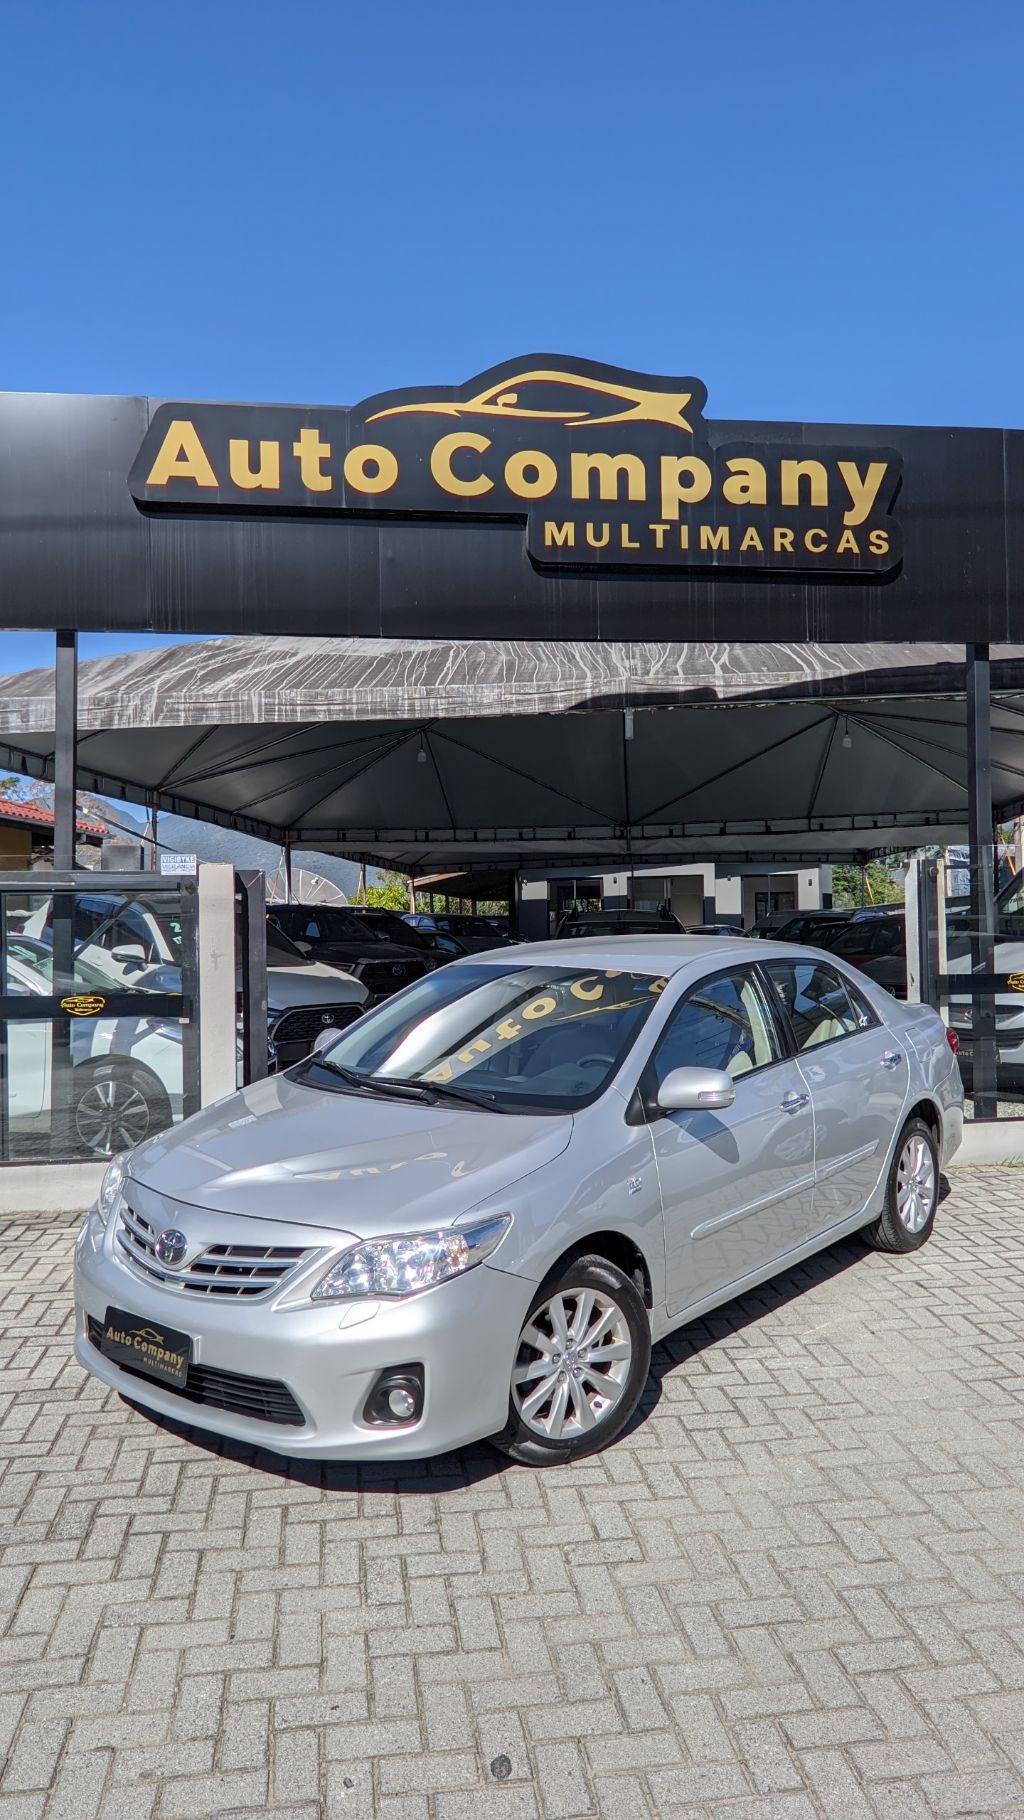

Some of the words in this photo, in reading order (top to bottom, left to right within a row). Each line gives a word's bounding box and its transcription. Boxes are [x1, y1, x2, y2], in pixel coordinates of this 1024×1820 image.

[146, 419, 398, 495] Auto
[430, 431, 889, 526] Company
[543, 520, 891, 555] MULTIMARCAS
[106, 1327, 131, 1345] Auto
[134, 1338, 184, 1368] Company
[143, 1357, 182, 1376] MULTIMARCAS
